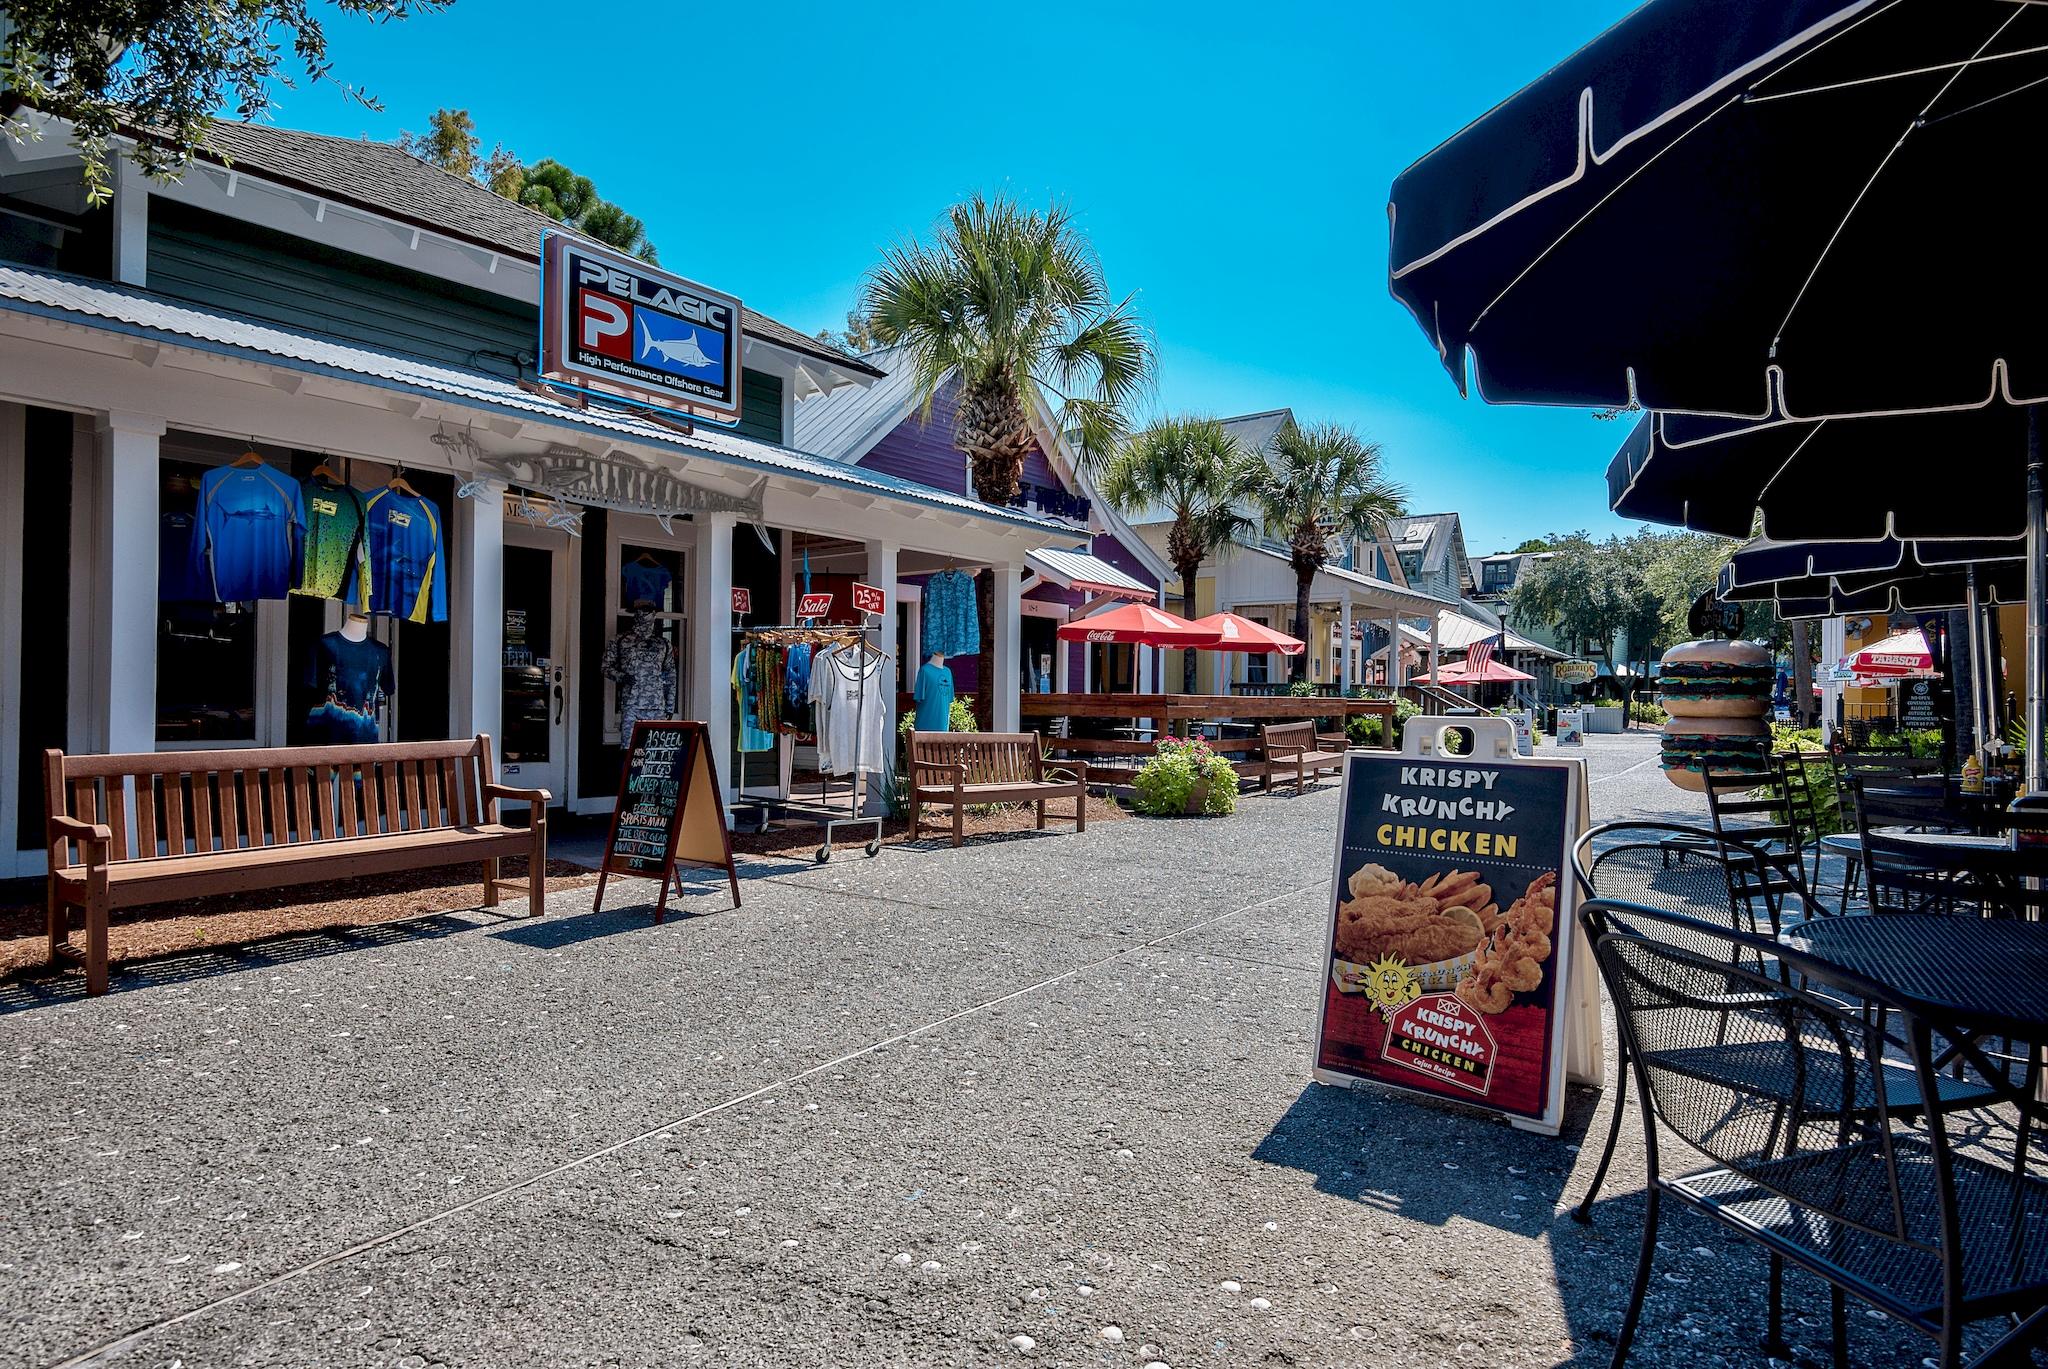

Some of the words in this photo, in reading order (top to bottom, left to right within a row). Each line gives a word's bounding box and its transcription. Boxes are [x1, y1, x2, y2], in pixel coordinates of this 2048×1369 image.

[579, 259, 726, 330] PELAGIC
[584, 294, 629, 348] P
[579, 351, 603, 368] High
[603, 358, 663, 383] Performance
[664, 374, 702, 394] Offshore
[703, 385, 724, 399] Gear
[800, 598, 827, 613] Sale
[868, 601, 880, 610] OFF
[1871, 653, 1921, 667] TABASCO
[1401, 767, 1499, 789] KRISPY
[1382, 793, 1515, 821] KRUNCHY
[1377, 824, 1517, 857] CHICKEN
[1417, 1007, 1476, 1036] KRISPY
[1402, 1020, 1484, 1056] KRUNCHY
[1402, 1039, 1475, 1072] CHICKEN
[1413, 1057, 1432, 1069] Cajun
[1433, 1064, 1456, 1077] Recipe
